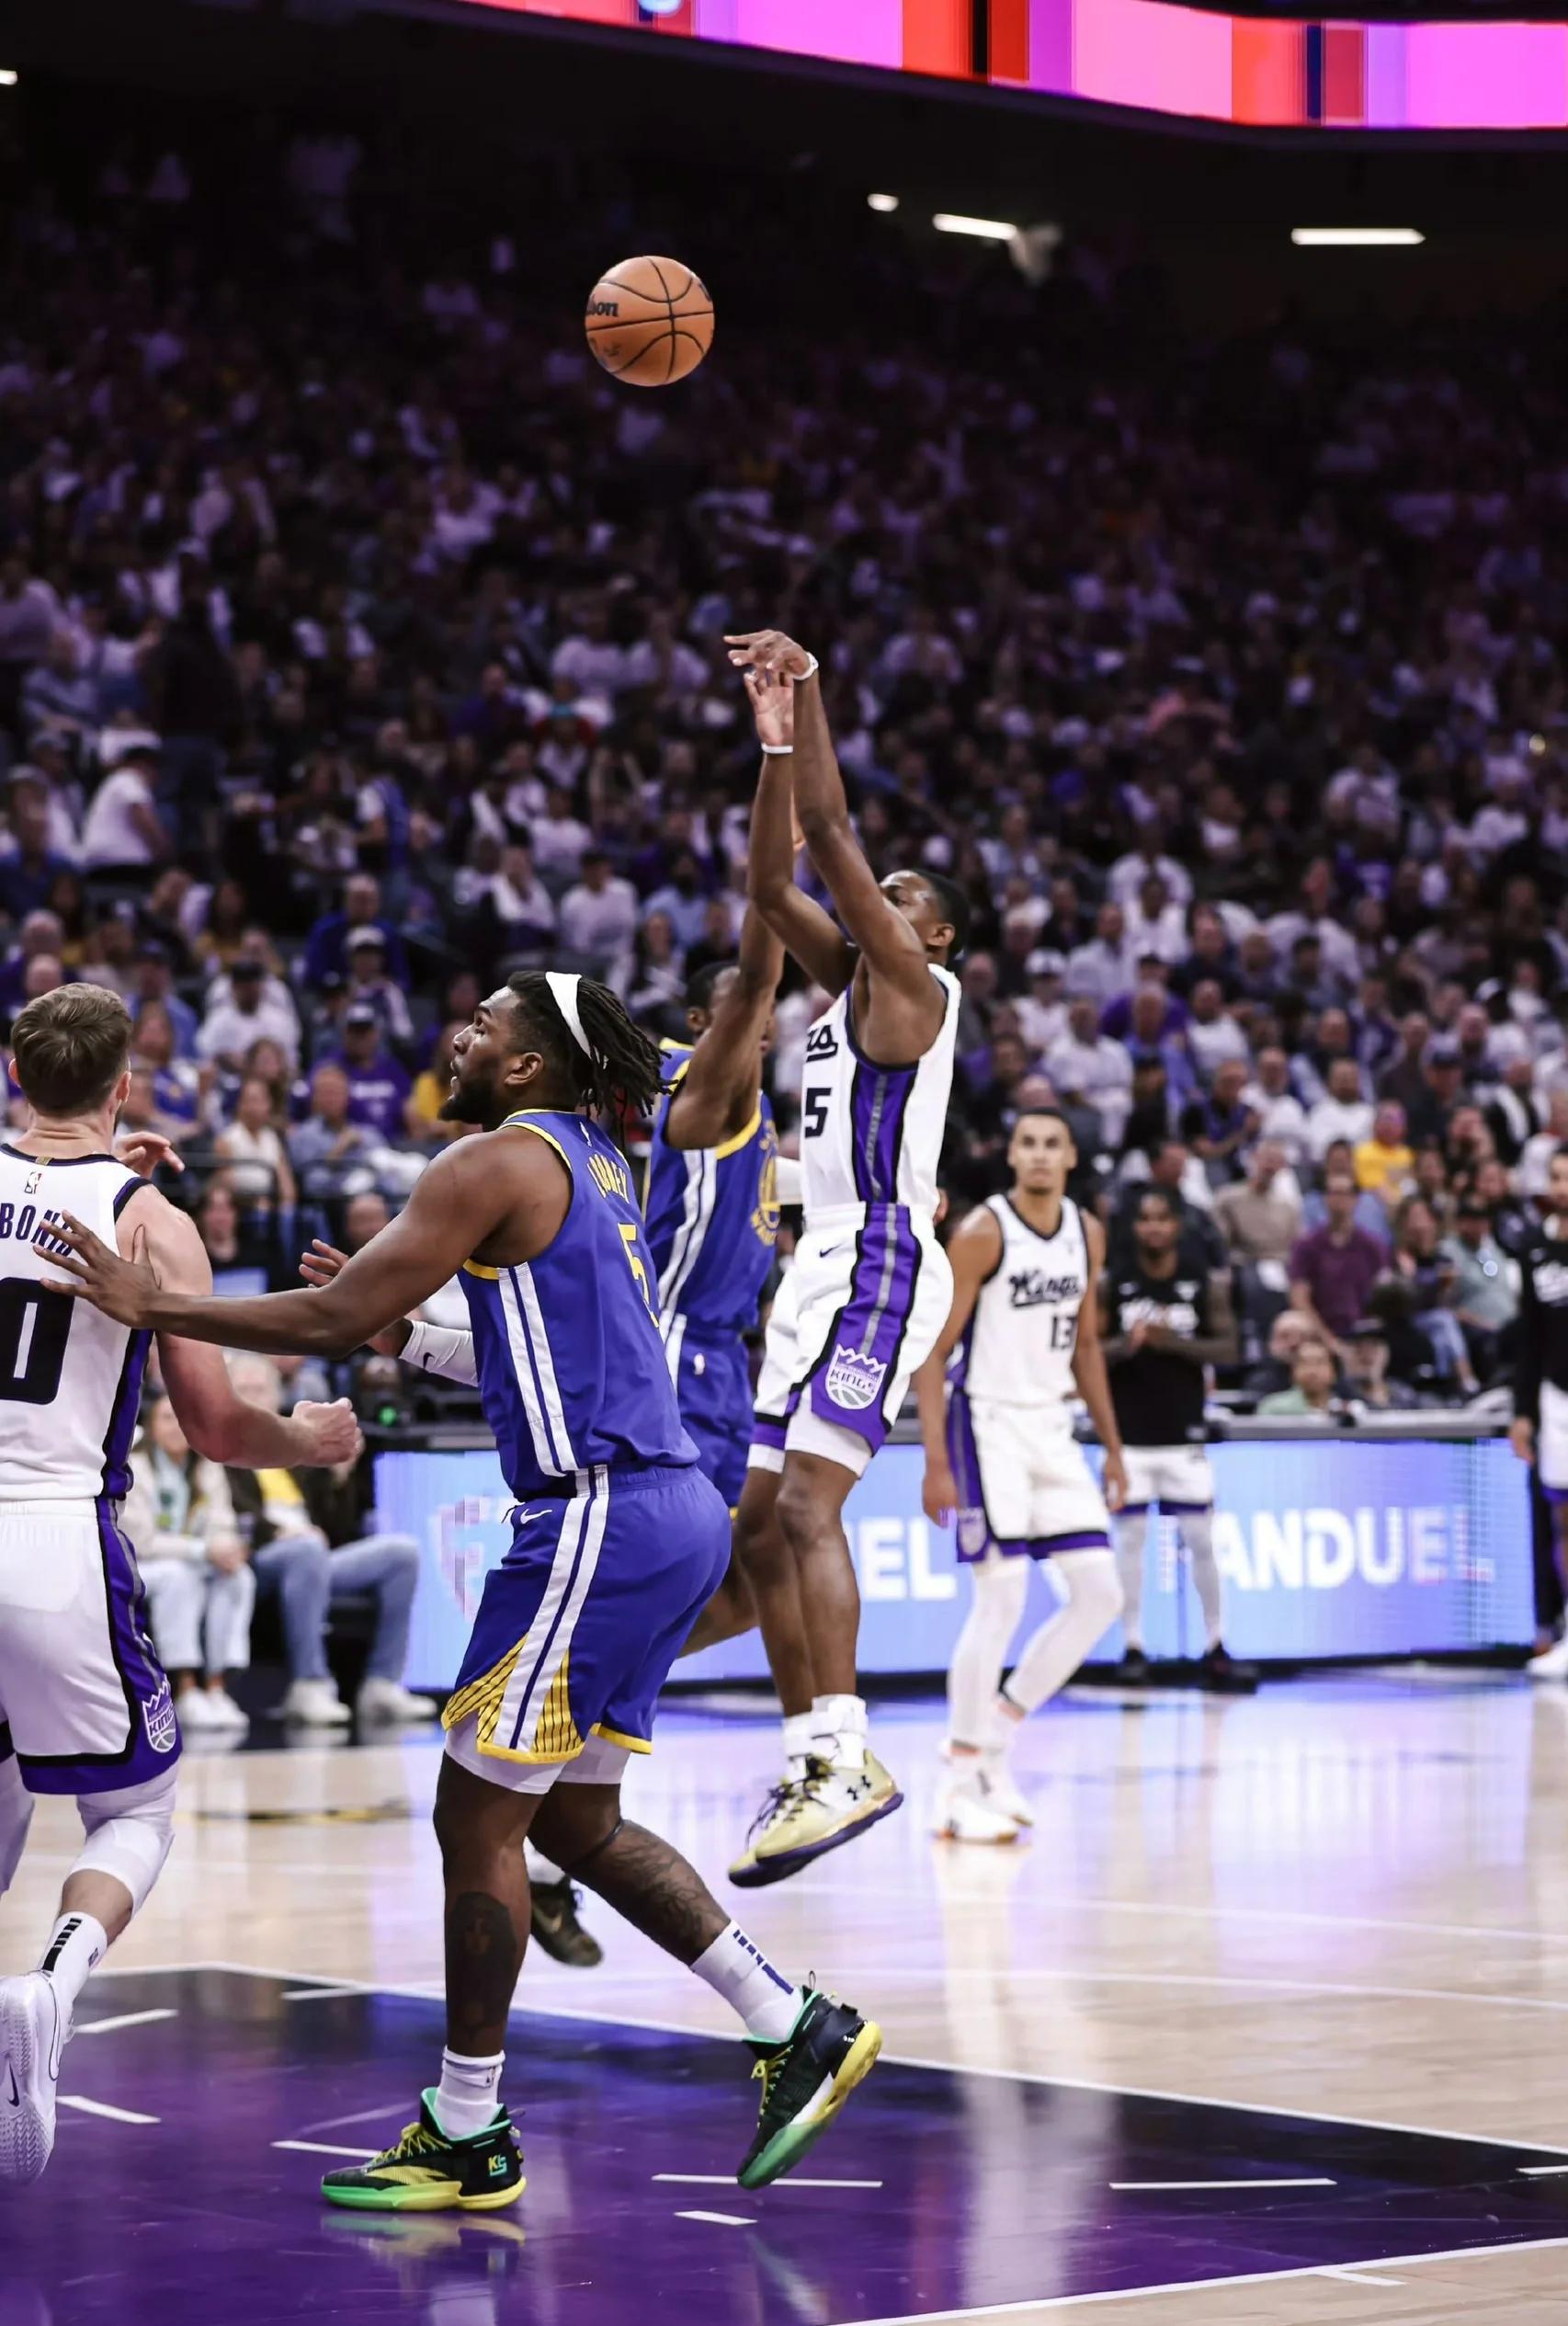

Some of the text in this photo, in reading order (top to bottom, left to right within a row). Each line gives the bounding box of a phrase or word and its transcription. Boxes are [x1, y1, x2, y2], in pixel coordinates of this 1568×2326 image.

[805, 1088, 832, 1139] 5
[618, 1223, 660, 1328] 5
[1051, 1315, 1078, 1351] 13
[844, 1516, 957, 1601] EL
